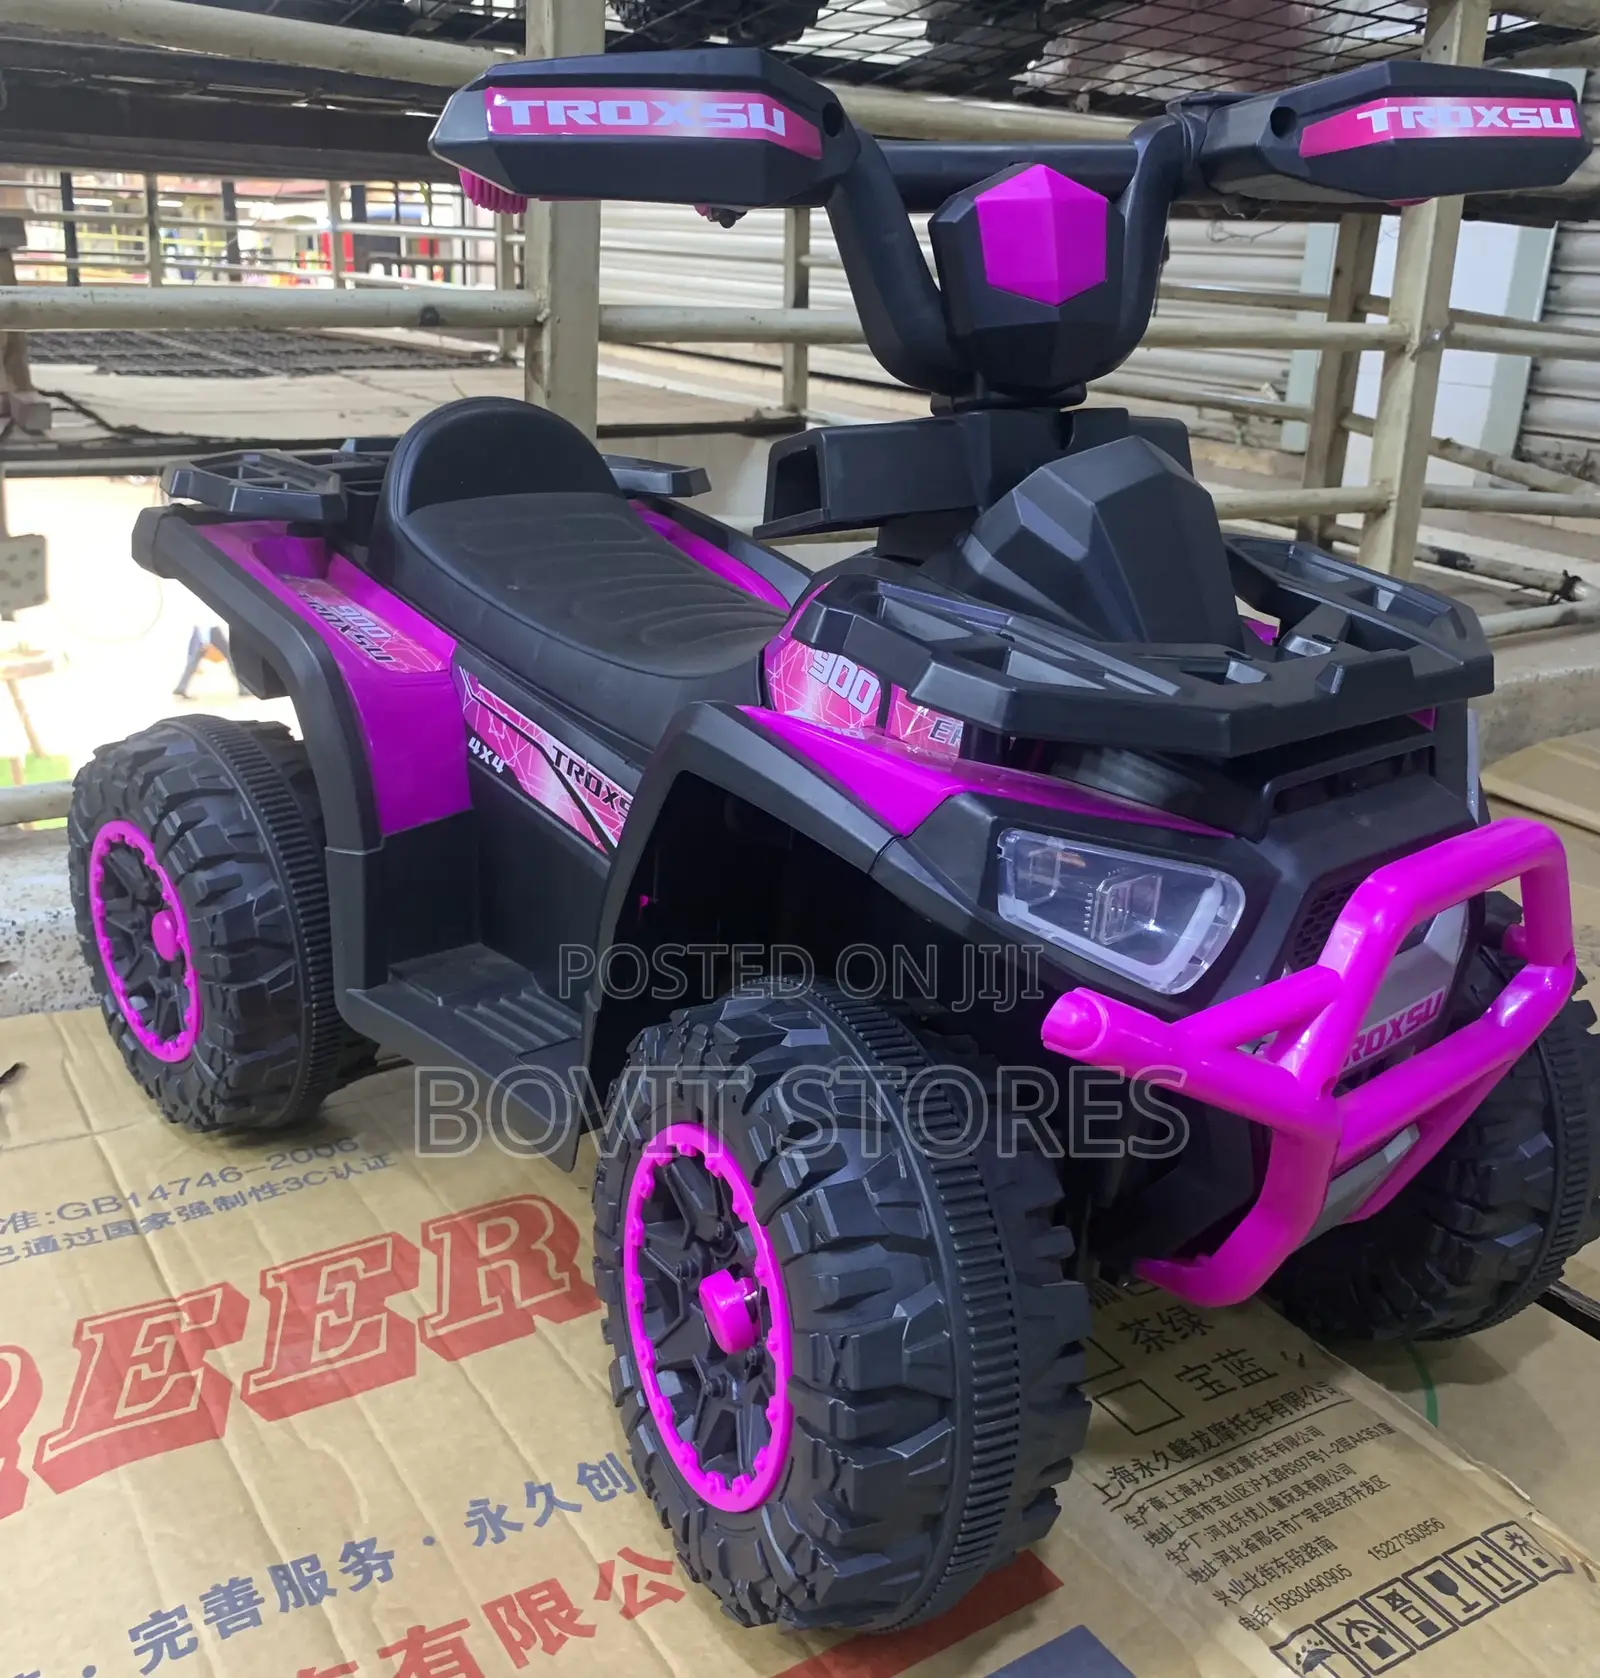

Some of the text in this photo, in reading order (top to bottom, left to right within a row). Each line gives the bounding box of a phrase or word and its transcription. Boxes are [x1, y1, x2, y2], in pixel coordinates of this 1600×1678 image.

[505, 99, 786, 138] TROXSU
[1357, 105, 1575, 133] TROXSU
[330, 605, 392, 638] 900
[807, 648, 880, 714] 900
[1116, 1304, 1215, 1354] 茶绿
[0, 1193, 600, 1520] EER
[1174, 1347, 1280, 1402] 宝蓝
[1367, 1517, 1447, 1561] 15227350956
